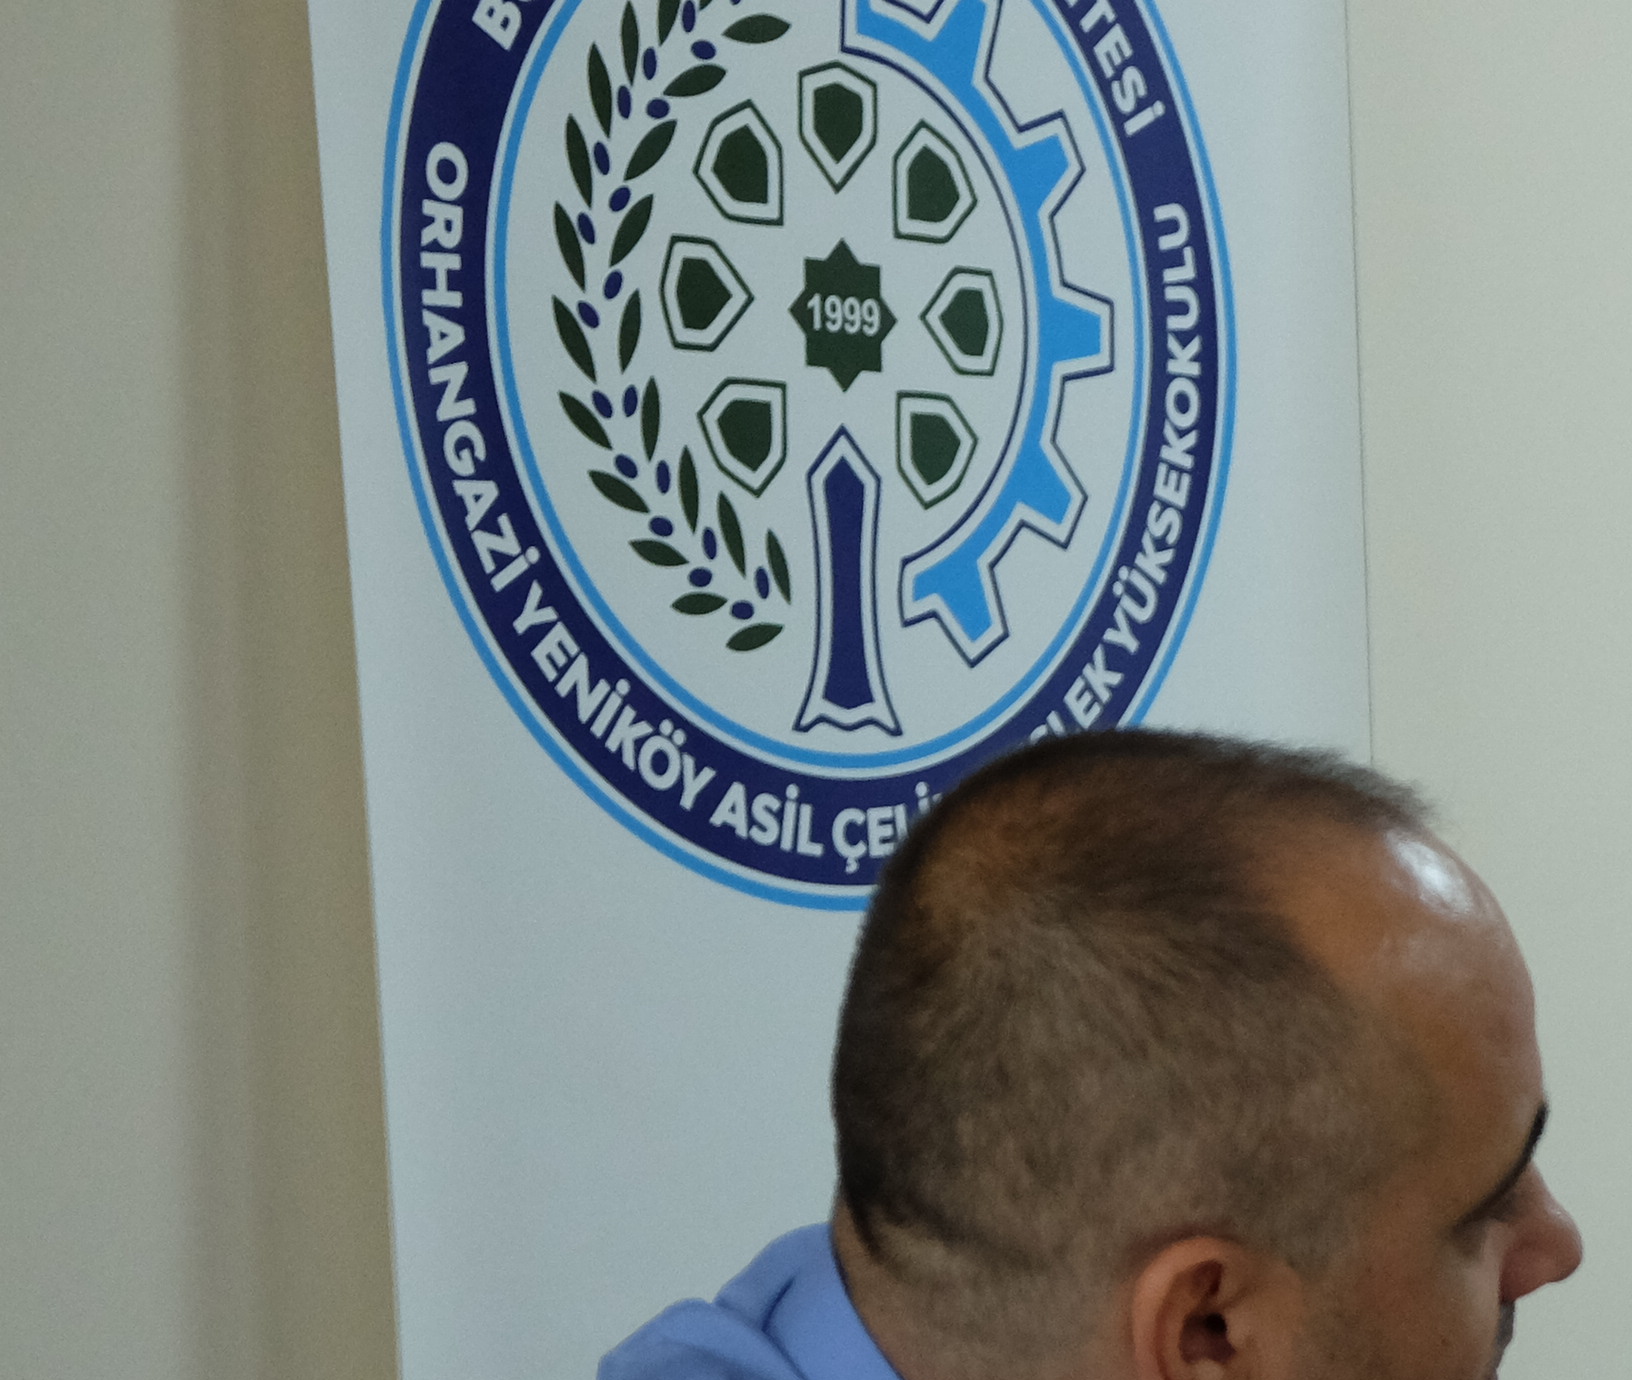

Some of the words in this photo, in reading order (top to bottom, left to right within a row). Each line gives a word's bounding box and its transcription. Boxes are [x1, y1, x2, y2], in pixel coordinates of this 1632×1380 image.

[420, 141, 540, 592] ORHANGAZİ
[513, 580, 716, 811] YENİKÖY
[709, 783, 824, 857] ASİL
[1102, 202, 1202, 656] YÜKSEKOKULU
[807, 293, 881, 337] 1999
